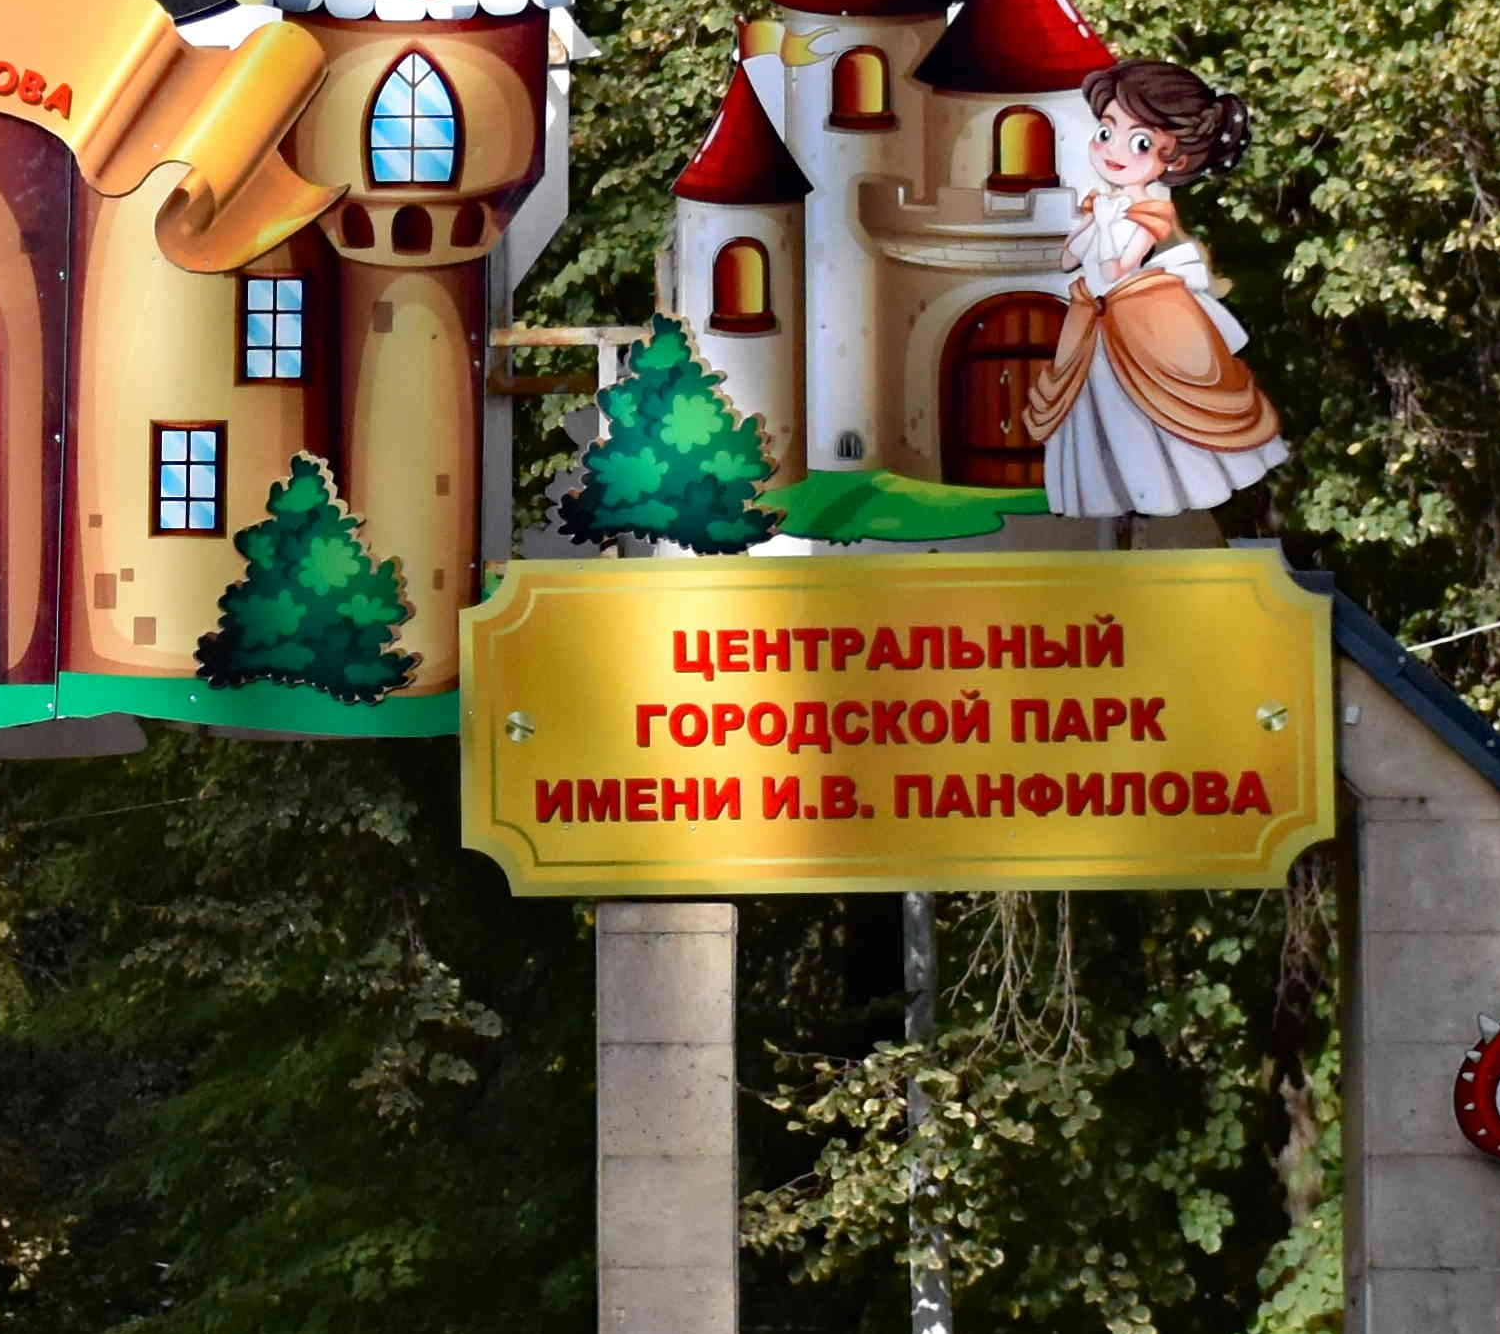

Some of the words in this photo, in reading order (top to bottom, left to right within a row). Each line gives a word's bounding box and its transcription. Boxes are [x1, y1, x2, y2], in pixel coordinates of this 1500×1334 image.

[673, 613, 1125, 681] ЦЕНТРАЛЬНЫЙ
[635, 689, 989, 753] ГОРОДСКОЙ
[1010, 697, 1167, 744] ПАРК
[535, 777, 742, 823] ИМЕНИ
[762, 775, 875, 821] И.В.
[893, 770, 1273, 819] ПАНФИЛОВА
